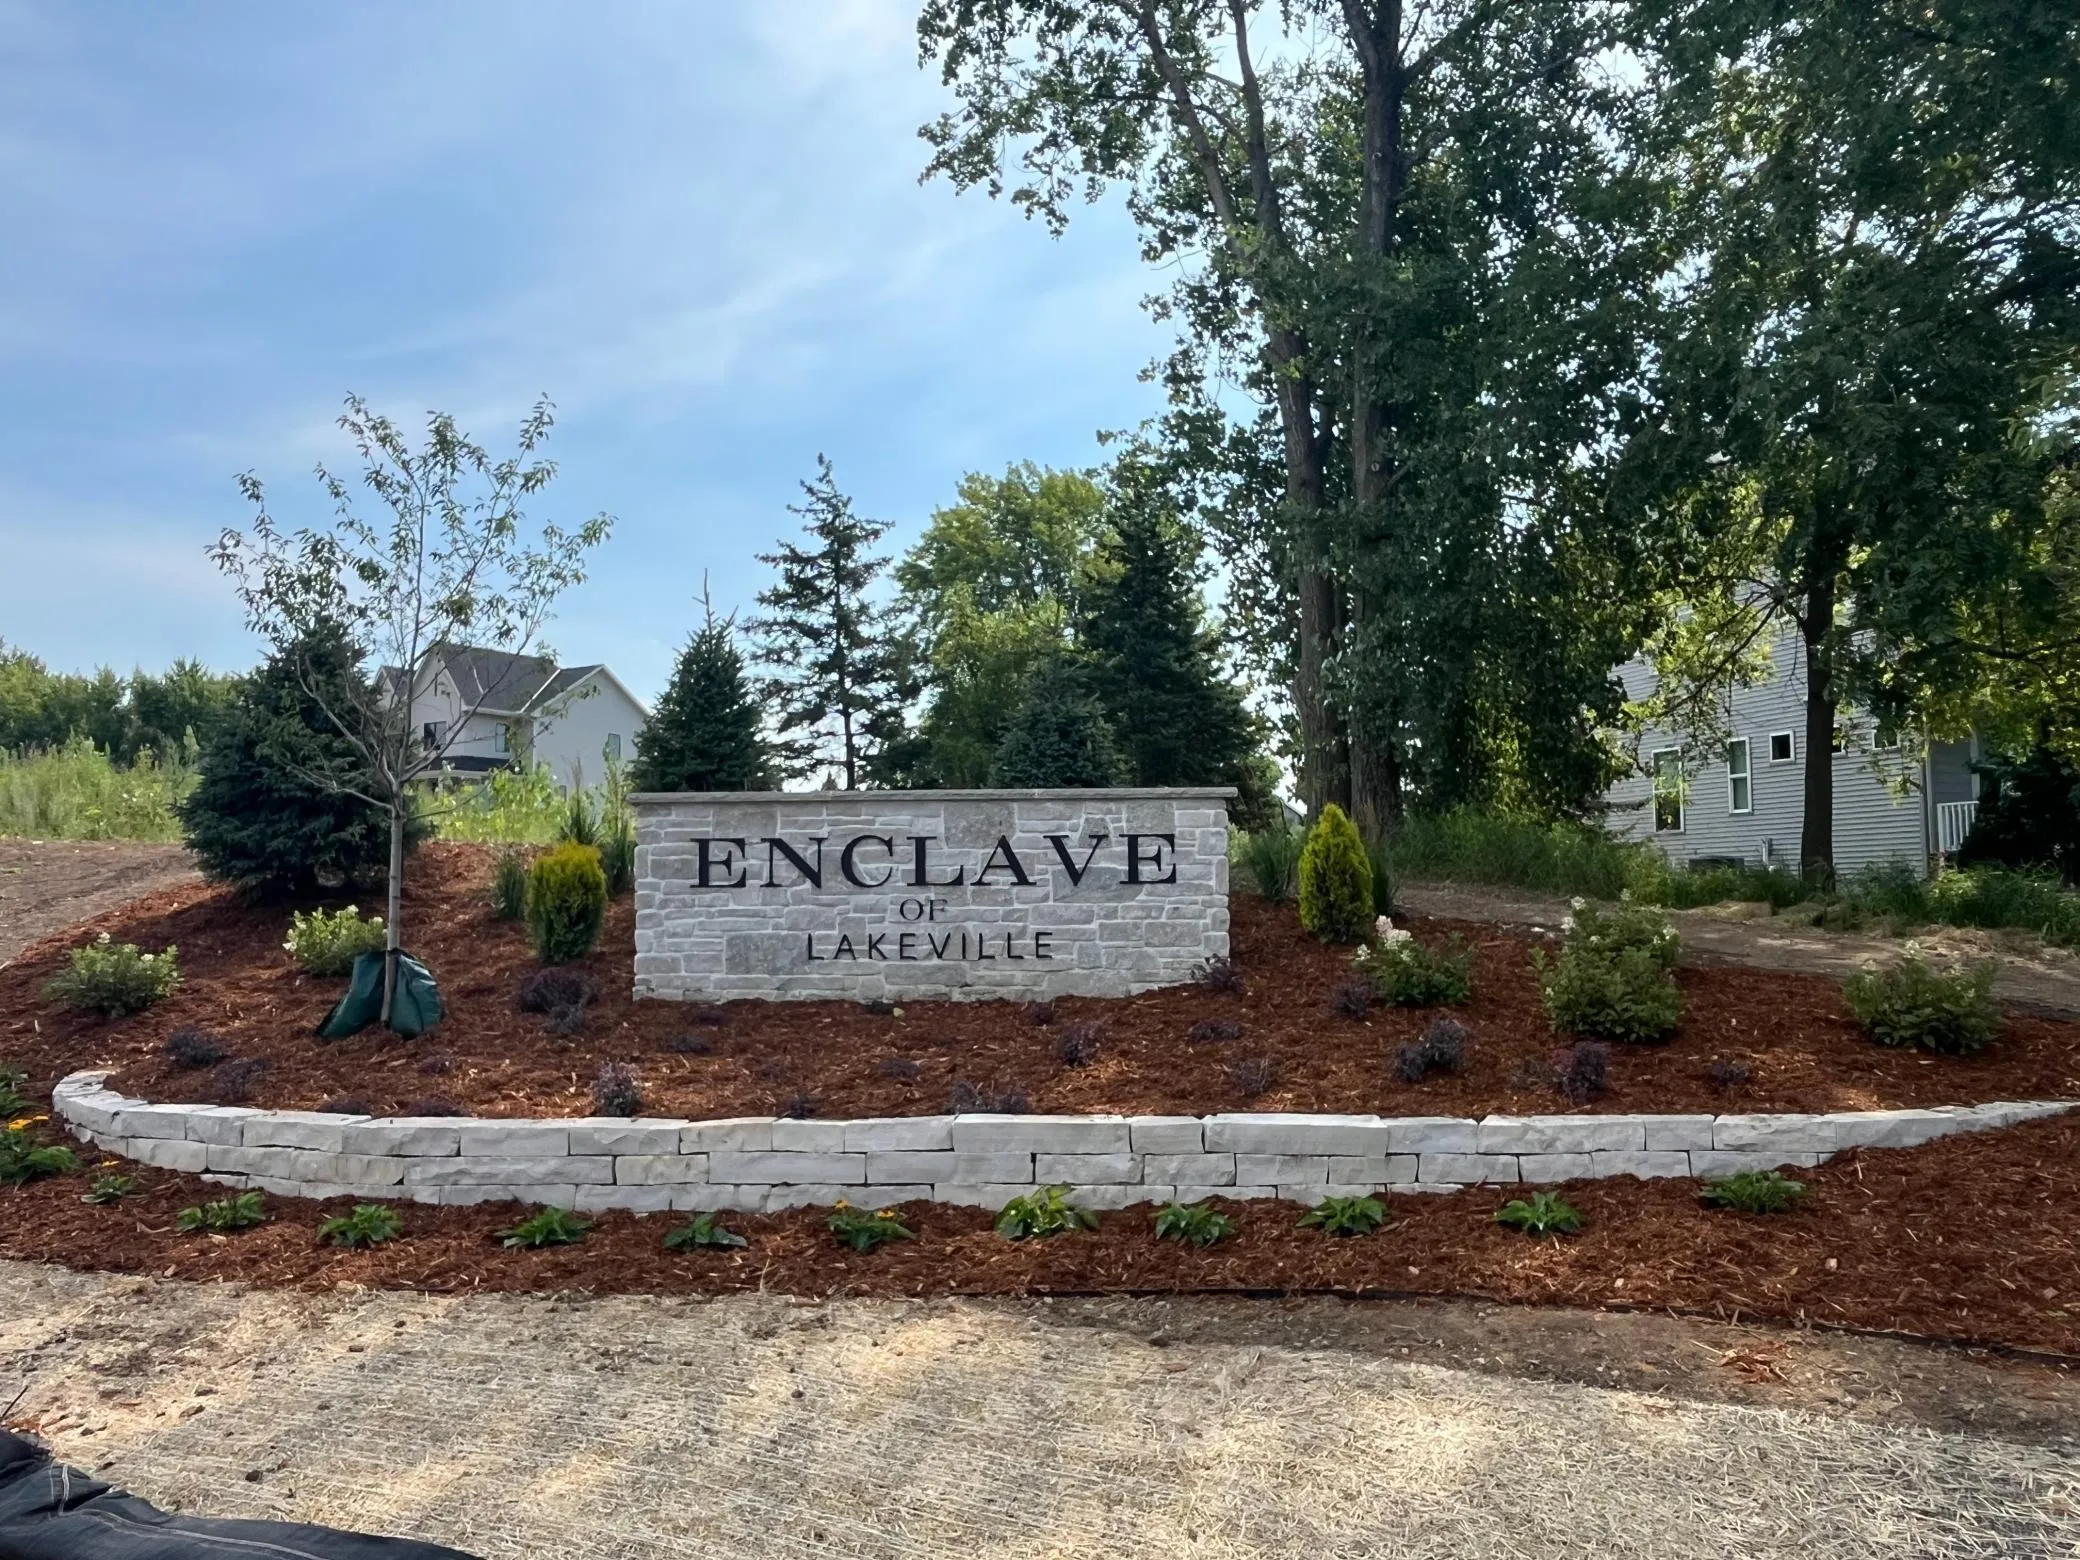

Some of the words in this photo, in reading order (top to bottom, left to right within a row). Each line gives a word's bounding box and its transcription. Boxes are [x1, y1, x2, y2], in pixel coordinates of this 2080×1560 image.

[689, 834, 1177, 889] ENCLAVE
[899, 898, 947, 921] OF
[807, 932, 1053, 961] LAKEVILLE
